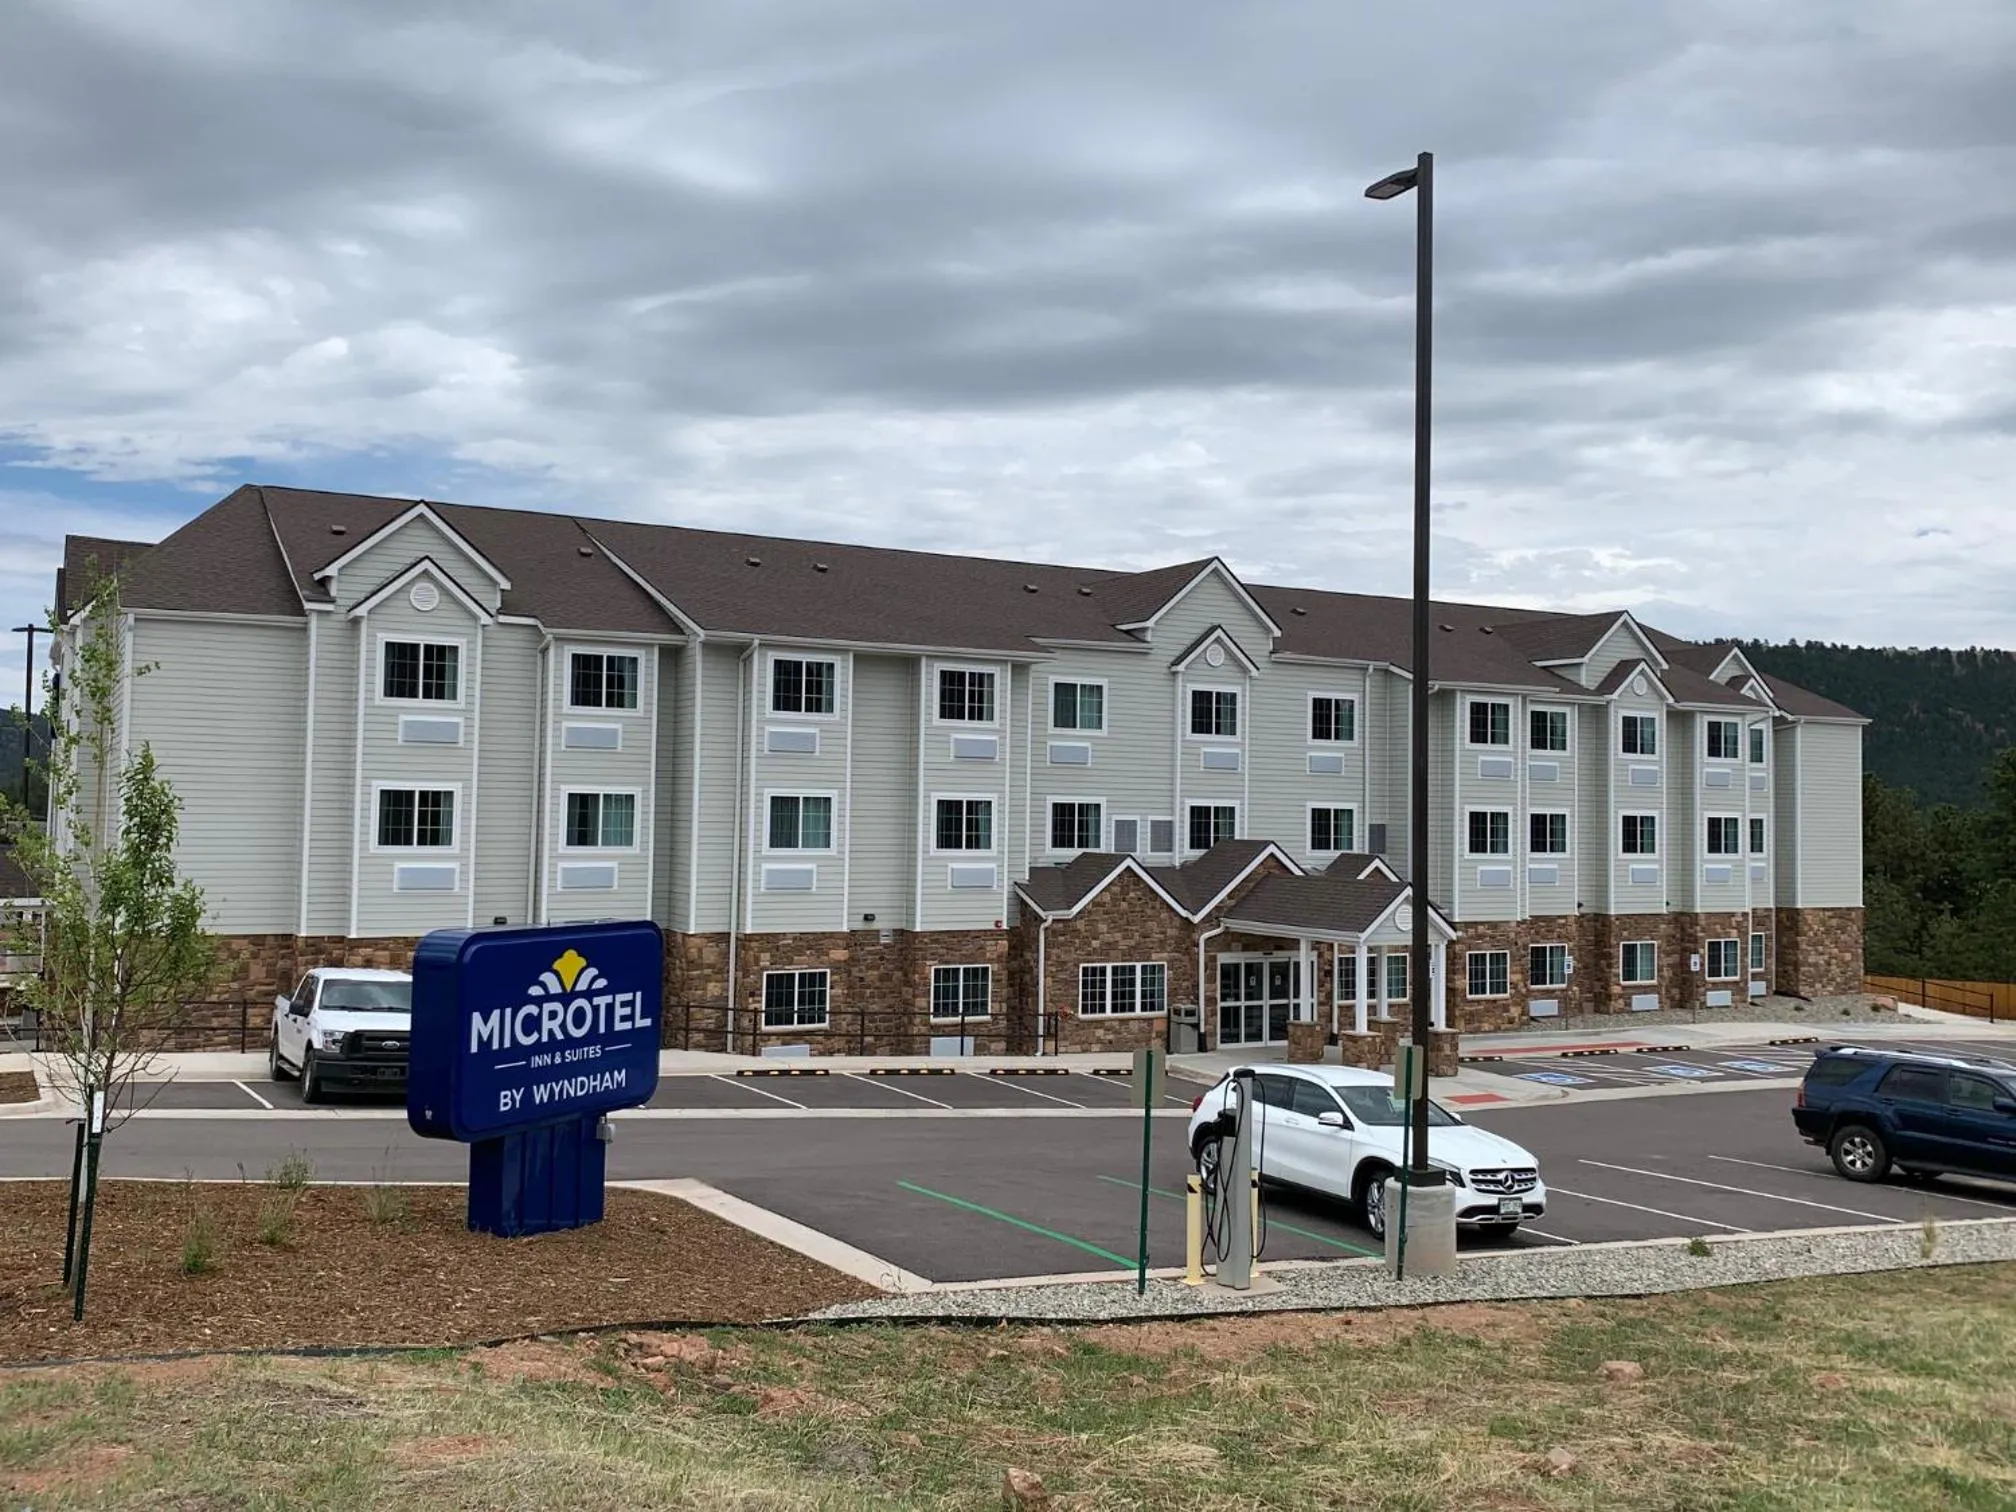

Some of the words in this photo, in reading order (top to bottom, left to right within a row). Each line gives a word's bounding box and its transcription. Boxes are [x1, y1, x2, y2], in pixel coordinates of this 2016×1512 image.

[470, 991, 652, 1053] MICROTEL
[530, 1053, 552, 1068] INN
[554, 1051, 562, 1064] &
[565, 1045, 602, 1062] SUITES
[499, 1087, 525, 1112] BY
[533, 1068, 626, 1105] WYNDHAM
